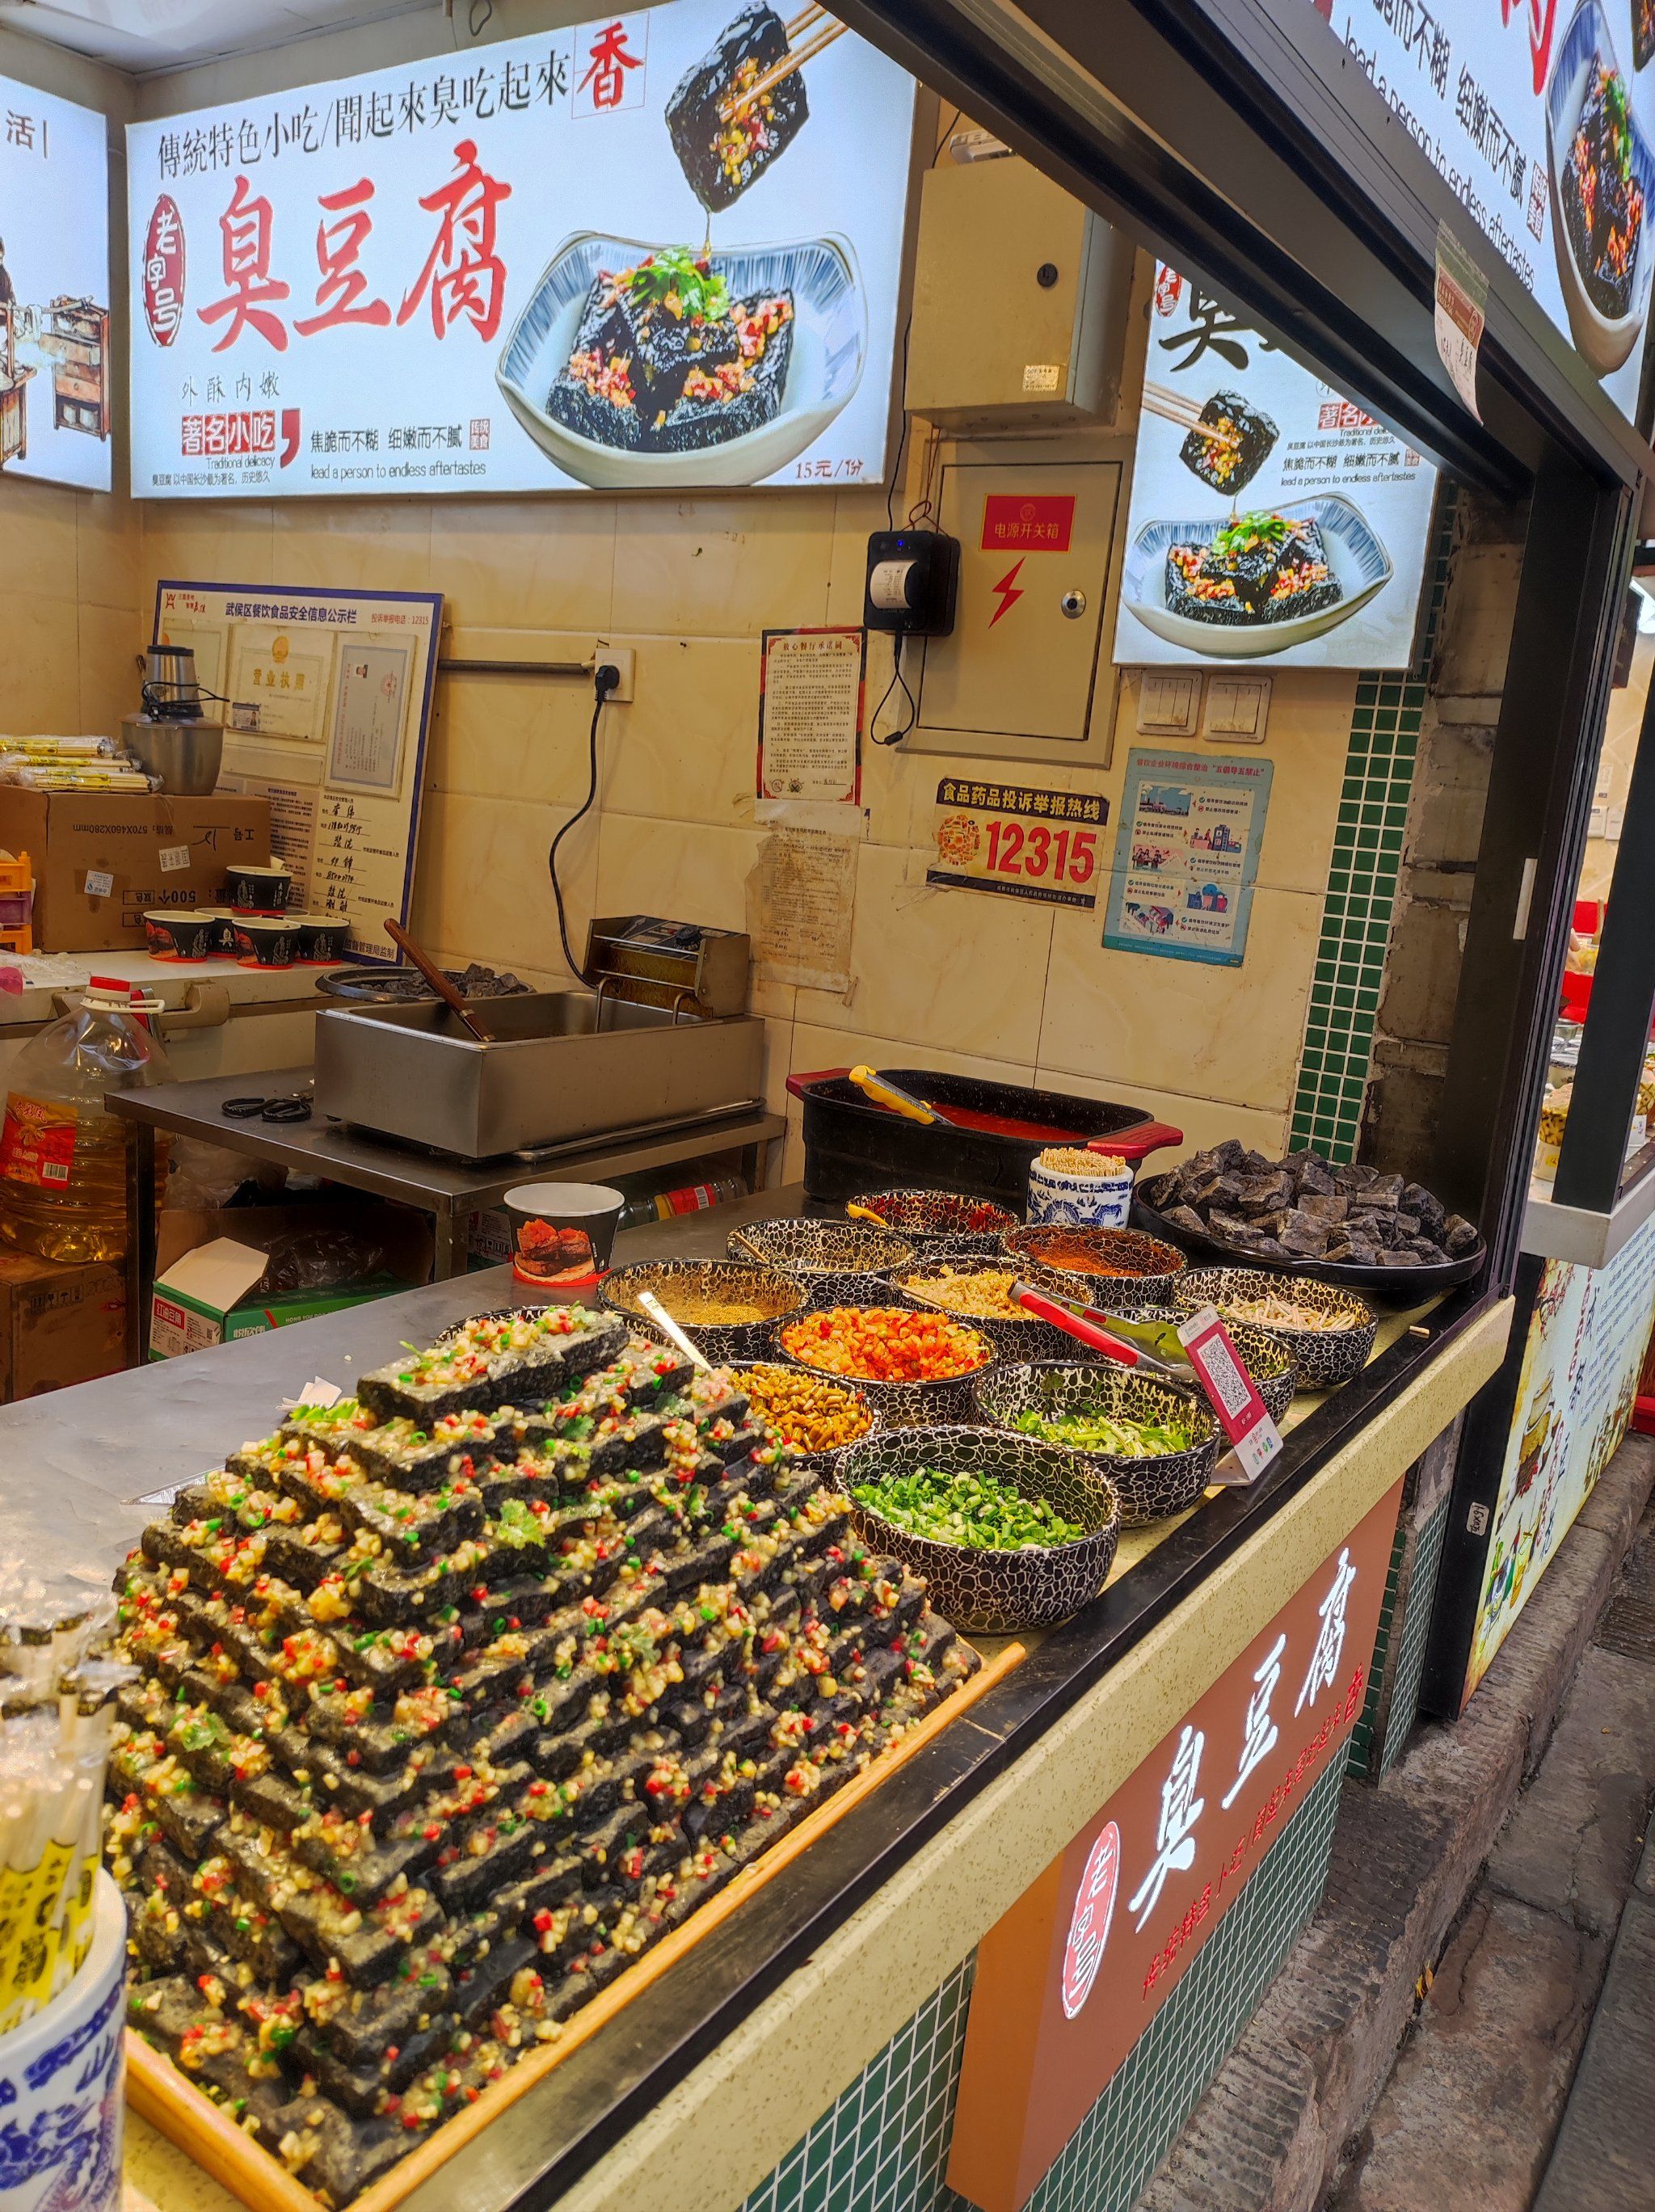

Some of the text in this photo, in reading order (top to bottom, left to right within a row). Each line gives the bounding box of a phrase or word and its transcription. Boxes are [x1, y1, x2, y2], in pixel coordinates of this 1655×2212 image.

[1455, 61, 1527, 209] 细嫩而不腻
[1345, 16, 1377, 82] lead
[1378, 75, 1387, 96] a
[1389, 88, 1432, 158] person
[1435, 137, 1447, 178] to
[1448, 167, 1488, 232] endless
[1489, 213, 1535, 294] aftertastes
[196, 138, 512, 353] 臭豆腐
[145, 209, 179, 333] 老字号
[182, 373, 280, 406] 外酥内嫩
[183, 411, 276, 454] 著名小吃
[310, 425, 463, 453] 焦脆而不糊 细嫩而不腻
[206, 454, 276, 470] Traditional delicacy
[311, 461, 486, 482] lead a person to endless aftertastes
[795, 460, 864, 480] 15元/份
[1281, 478, 1296, 486] lead
[1304, 476, 1330, 487] person
[1333, 475, 1340, 484] to
[1342, 474, 1371, 483] endless
[1373, 472, 1417, 482] aftertastes
[994, 523, 1060, 540] 电源开关箱
[225, 601, 357, 624] 武侯区餐饮食品安全信息公示栏
[253, 668, 305, 691] 营业执照
[943, 782, 1101, 821] 食品药品投诉举报热线
[234, 828, 255, 841] 工号
[985, 821, 1097, 884] 12315
[159, 890, 196, 904] 500个
[1130, 1546, 1357, 1934] 臭豆腐
